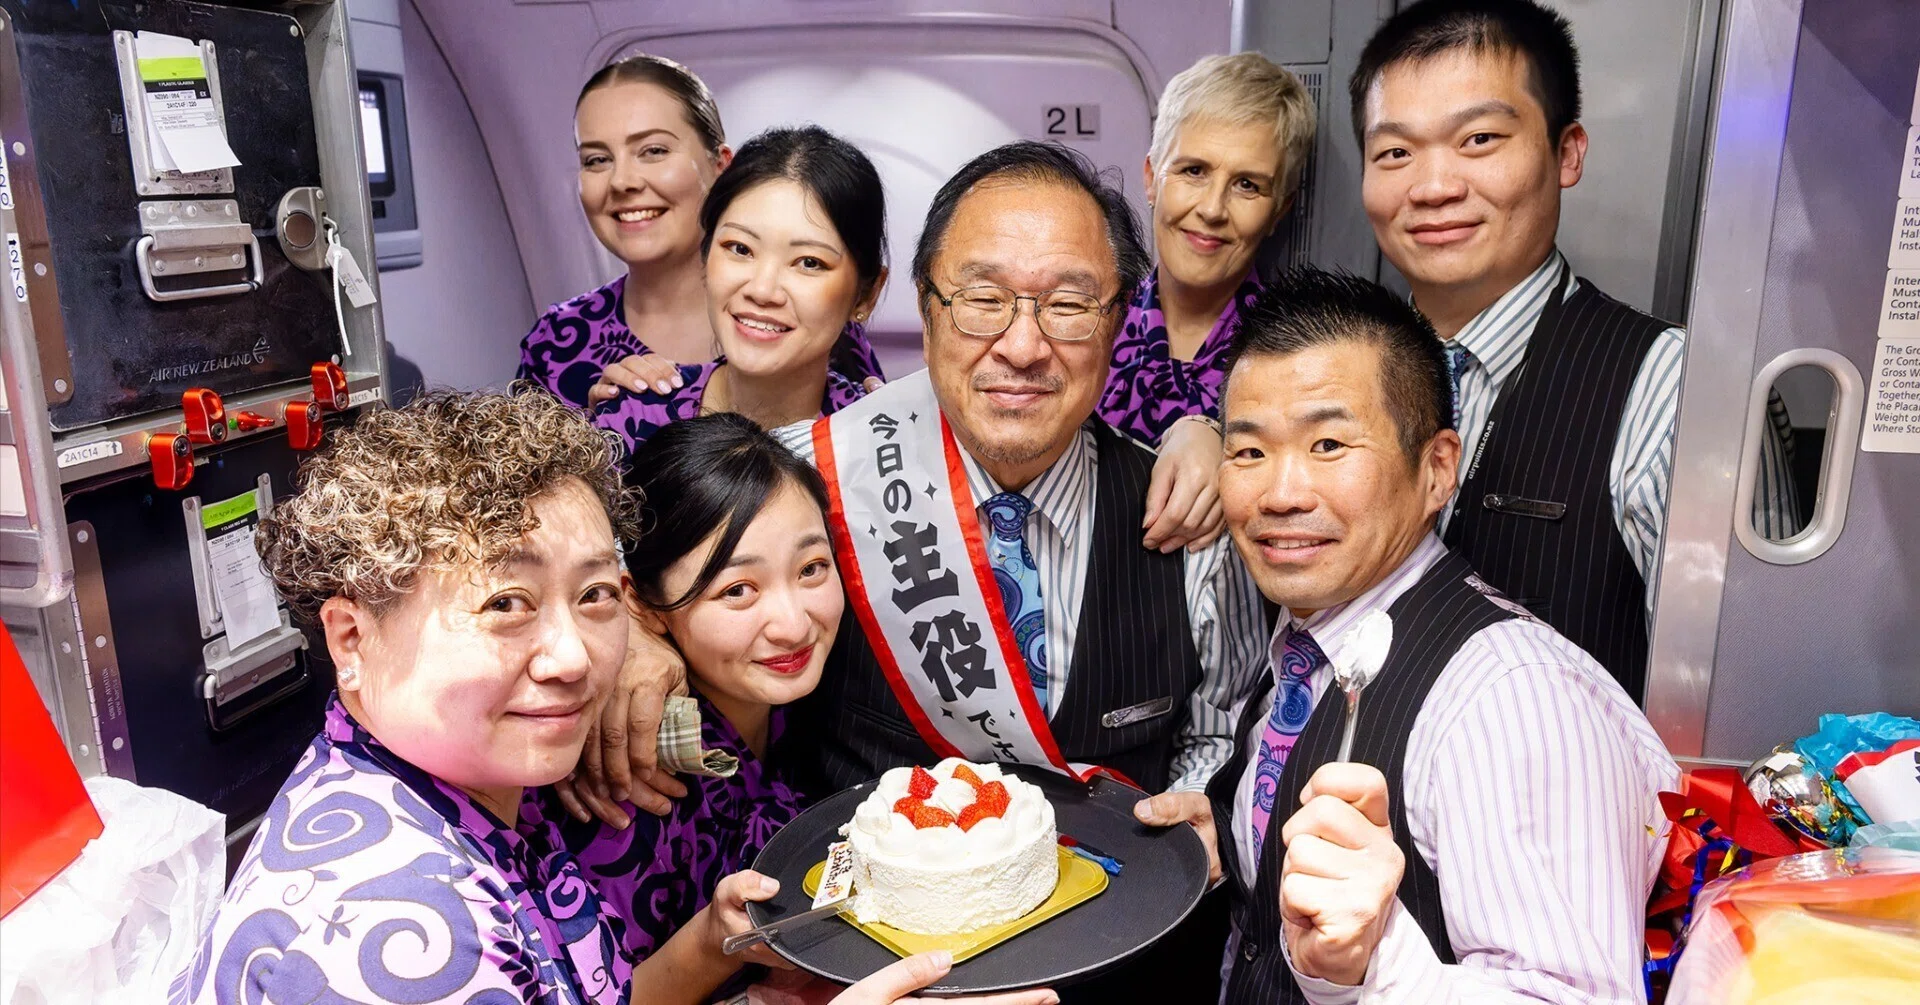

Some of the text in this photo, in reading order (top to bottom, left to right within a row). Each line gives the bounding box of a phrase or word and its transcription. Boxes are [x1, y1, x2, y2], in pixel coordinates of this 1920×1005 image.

[1899, 241, 1920, 250] Inst
[10, 250, 26, 299] 270
[1886, 346, 1902, 354] The
[149, 353, 251, 383] AIR NEW ZEALAND
[1882, 368, 1920, 377] Gross W
[1875, 412, 1908, 424] Weight
[1873, 424, 1904, 432] Where
[64, 447, 98, 463] 2A1C14
[1468, 420, 1495, 480] airpoints.co.nz
